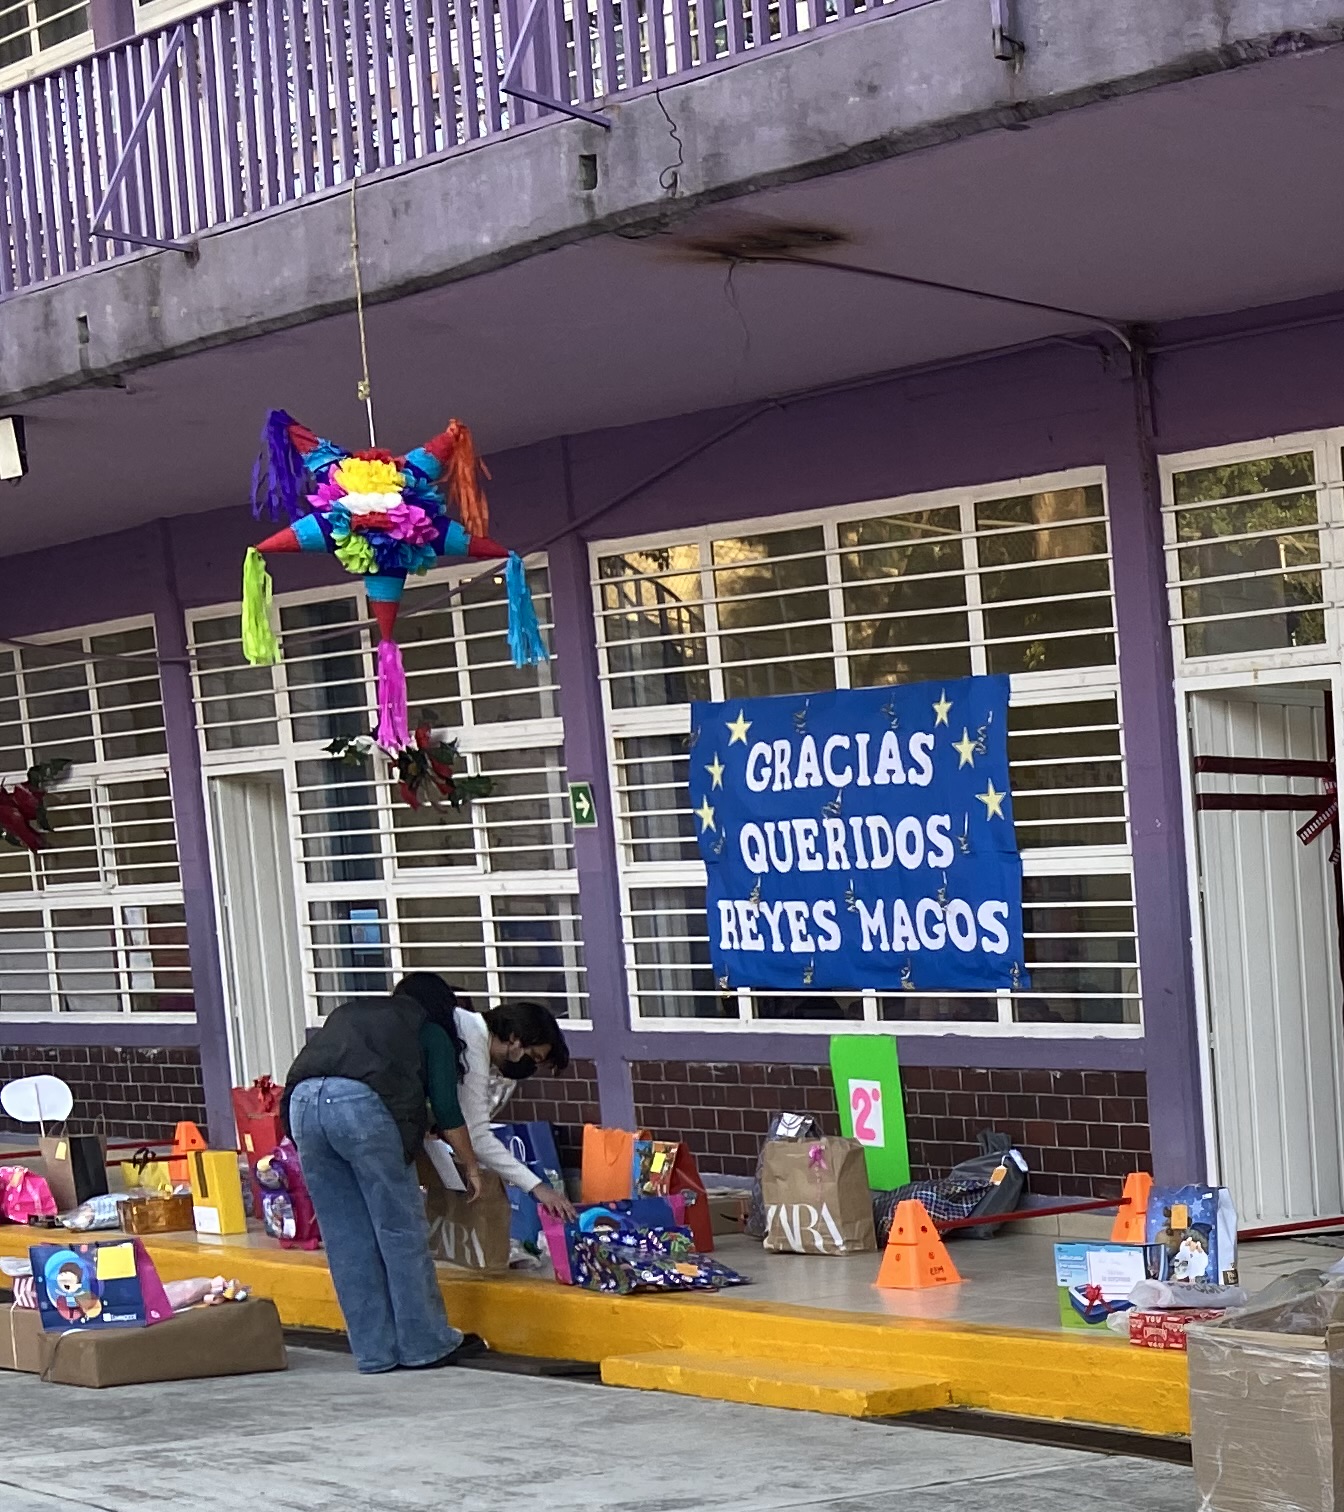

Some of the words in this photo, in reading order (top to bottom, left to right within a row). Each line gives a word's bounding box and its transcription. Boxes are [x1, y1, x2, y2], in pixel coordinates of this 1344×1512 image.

[744, 731, 936, 793] GRACIAS
[739, 813, 956, 874] QUERIDOS
[717, 899, 842, 953] REYES
[854, 898, 1010, 954] MAGOS
